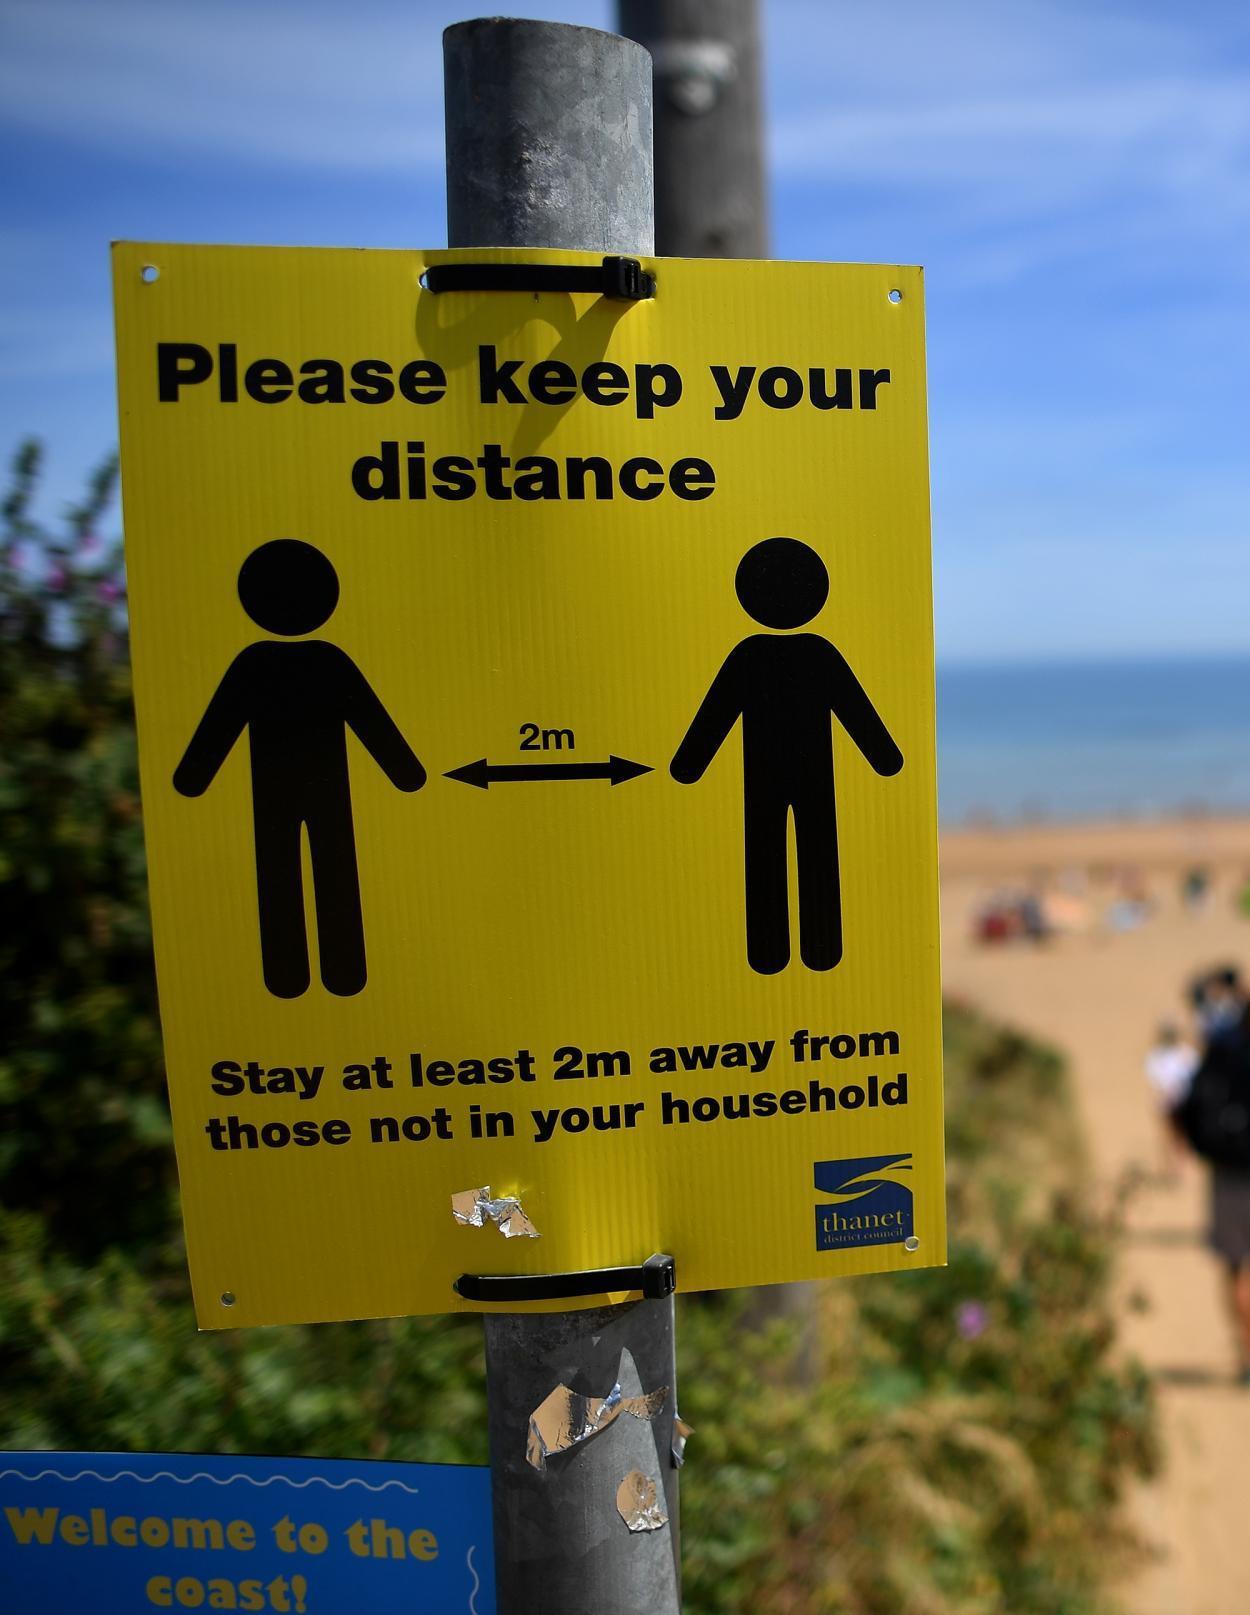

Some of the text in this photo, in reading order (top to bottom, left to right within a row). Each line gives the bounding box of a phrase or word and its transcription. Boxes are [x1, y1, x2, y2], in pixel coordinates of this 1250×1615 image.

[157, 342, 890, 420] Please keep your
[352, 441, 715, 500] distance
[520, 723, 574, 750] 2m
[211, 1030, 899, 1100] Stay at least 2m away from
[205, 1074, 908, 1150] those not in your household
[823, 1210, 904, 1232] thanet
[824, 1228, 903, 1243] district council
[4, 1507, 439, 1561] Welcome to the
[146, 1574, 307, 1613] coast!
